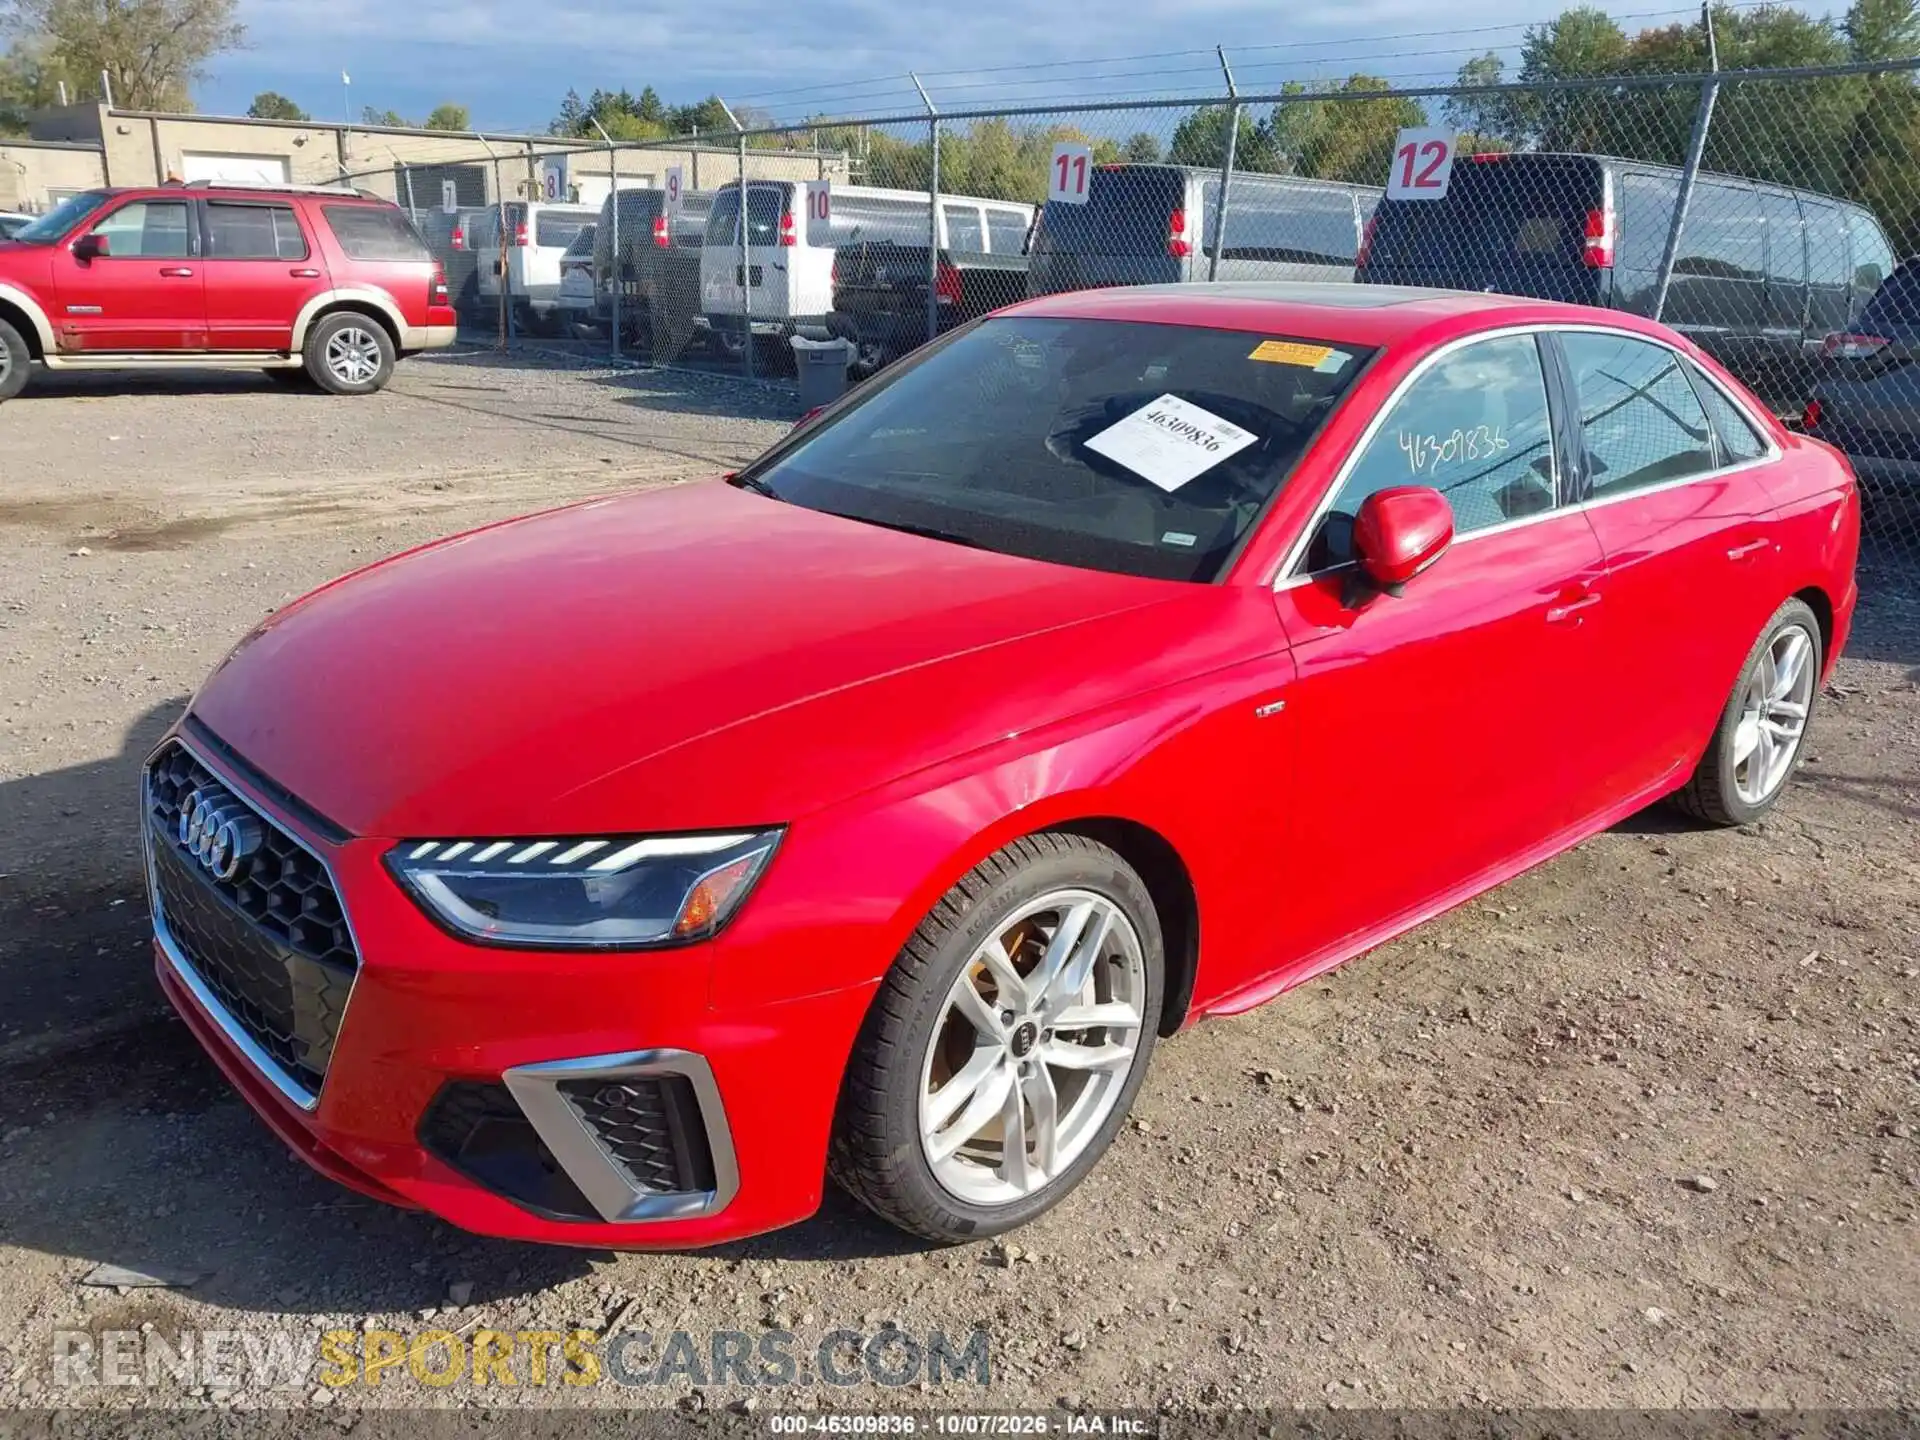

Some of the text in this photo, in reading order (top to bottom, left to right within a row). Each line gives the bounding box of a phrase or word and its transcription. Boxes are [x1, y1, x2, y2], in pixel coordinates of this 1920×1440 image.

[1056, 154, 1086, 194] 11
[1398, 140, 1448, 188] 12
[445, 183, 453, 209] 7
[547, 175, 556, 199] 8
[669, 175, 678, 202] 9
[806, 190, 829, 220] 10
[1146, 410, 1221, 453] 46309836
[1399, 425, 1510, 477] 46309836
